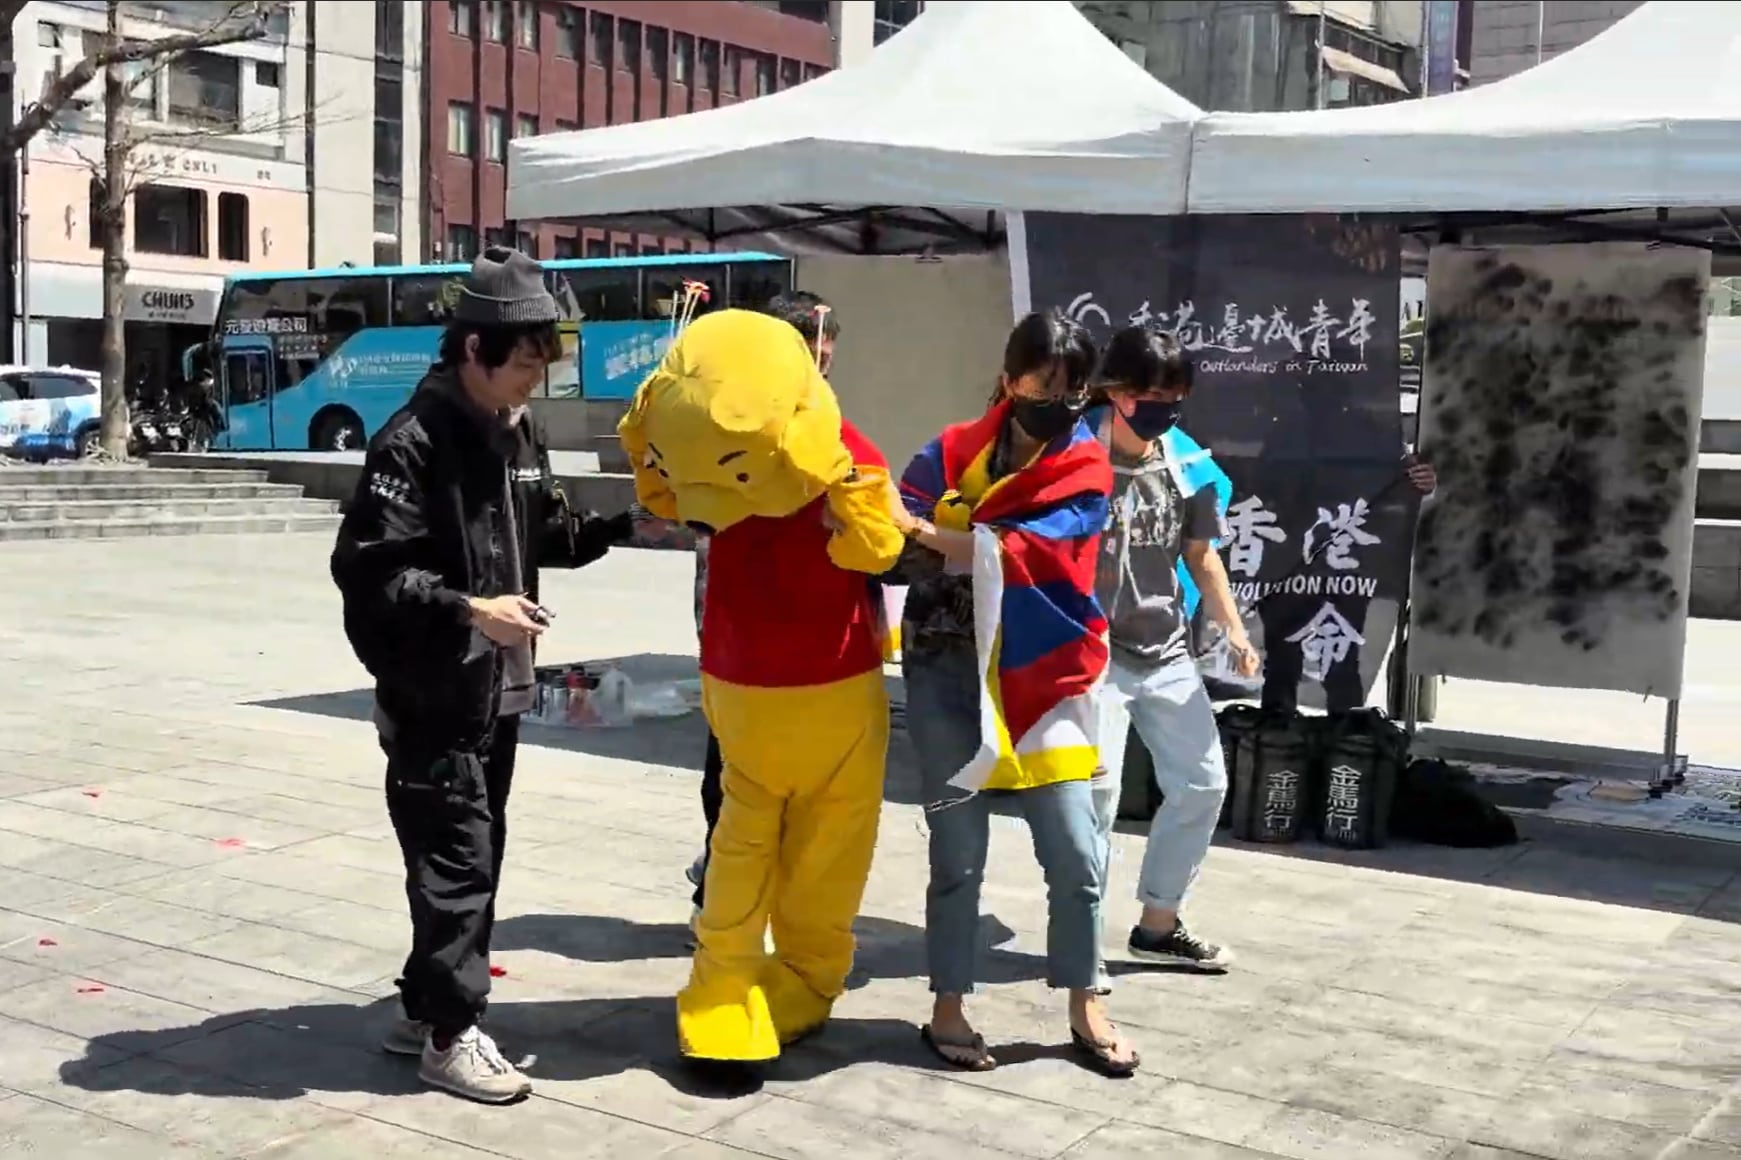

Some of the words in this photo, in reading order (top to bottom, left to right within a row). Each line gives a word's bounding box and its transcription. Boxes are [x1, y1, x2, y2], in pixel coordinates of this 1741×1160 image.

[1199, 356, 1277, 374] Outlanders
[1285, 360, 1302, 373] in
[1306, 359, 1369, 375] Taiwan
[1220, 494, 1382, 577] 香港
[1325, 574, 1378, 598] NOW
